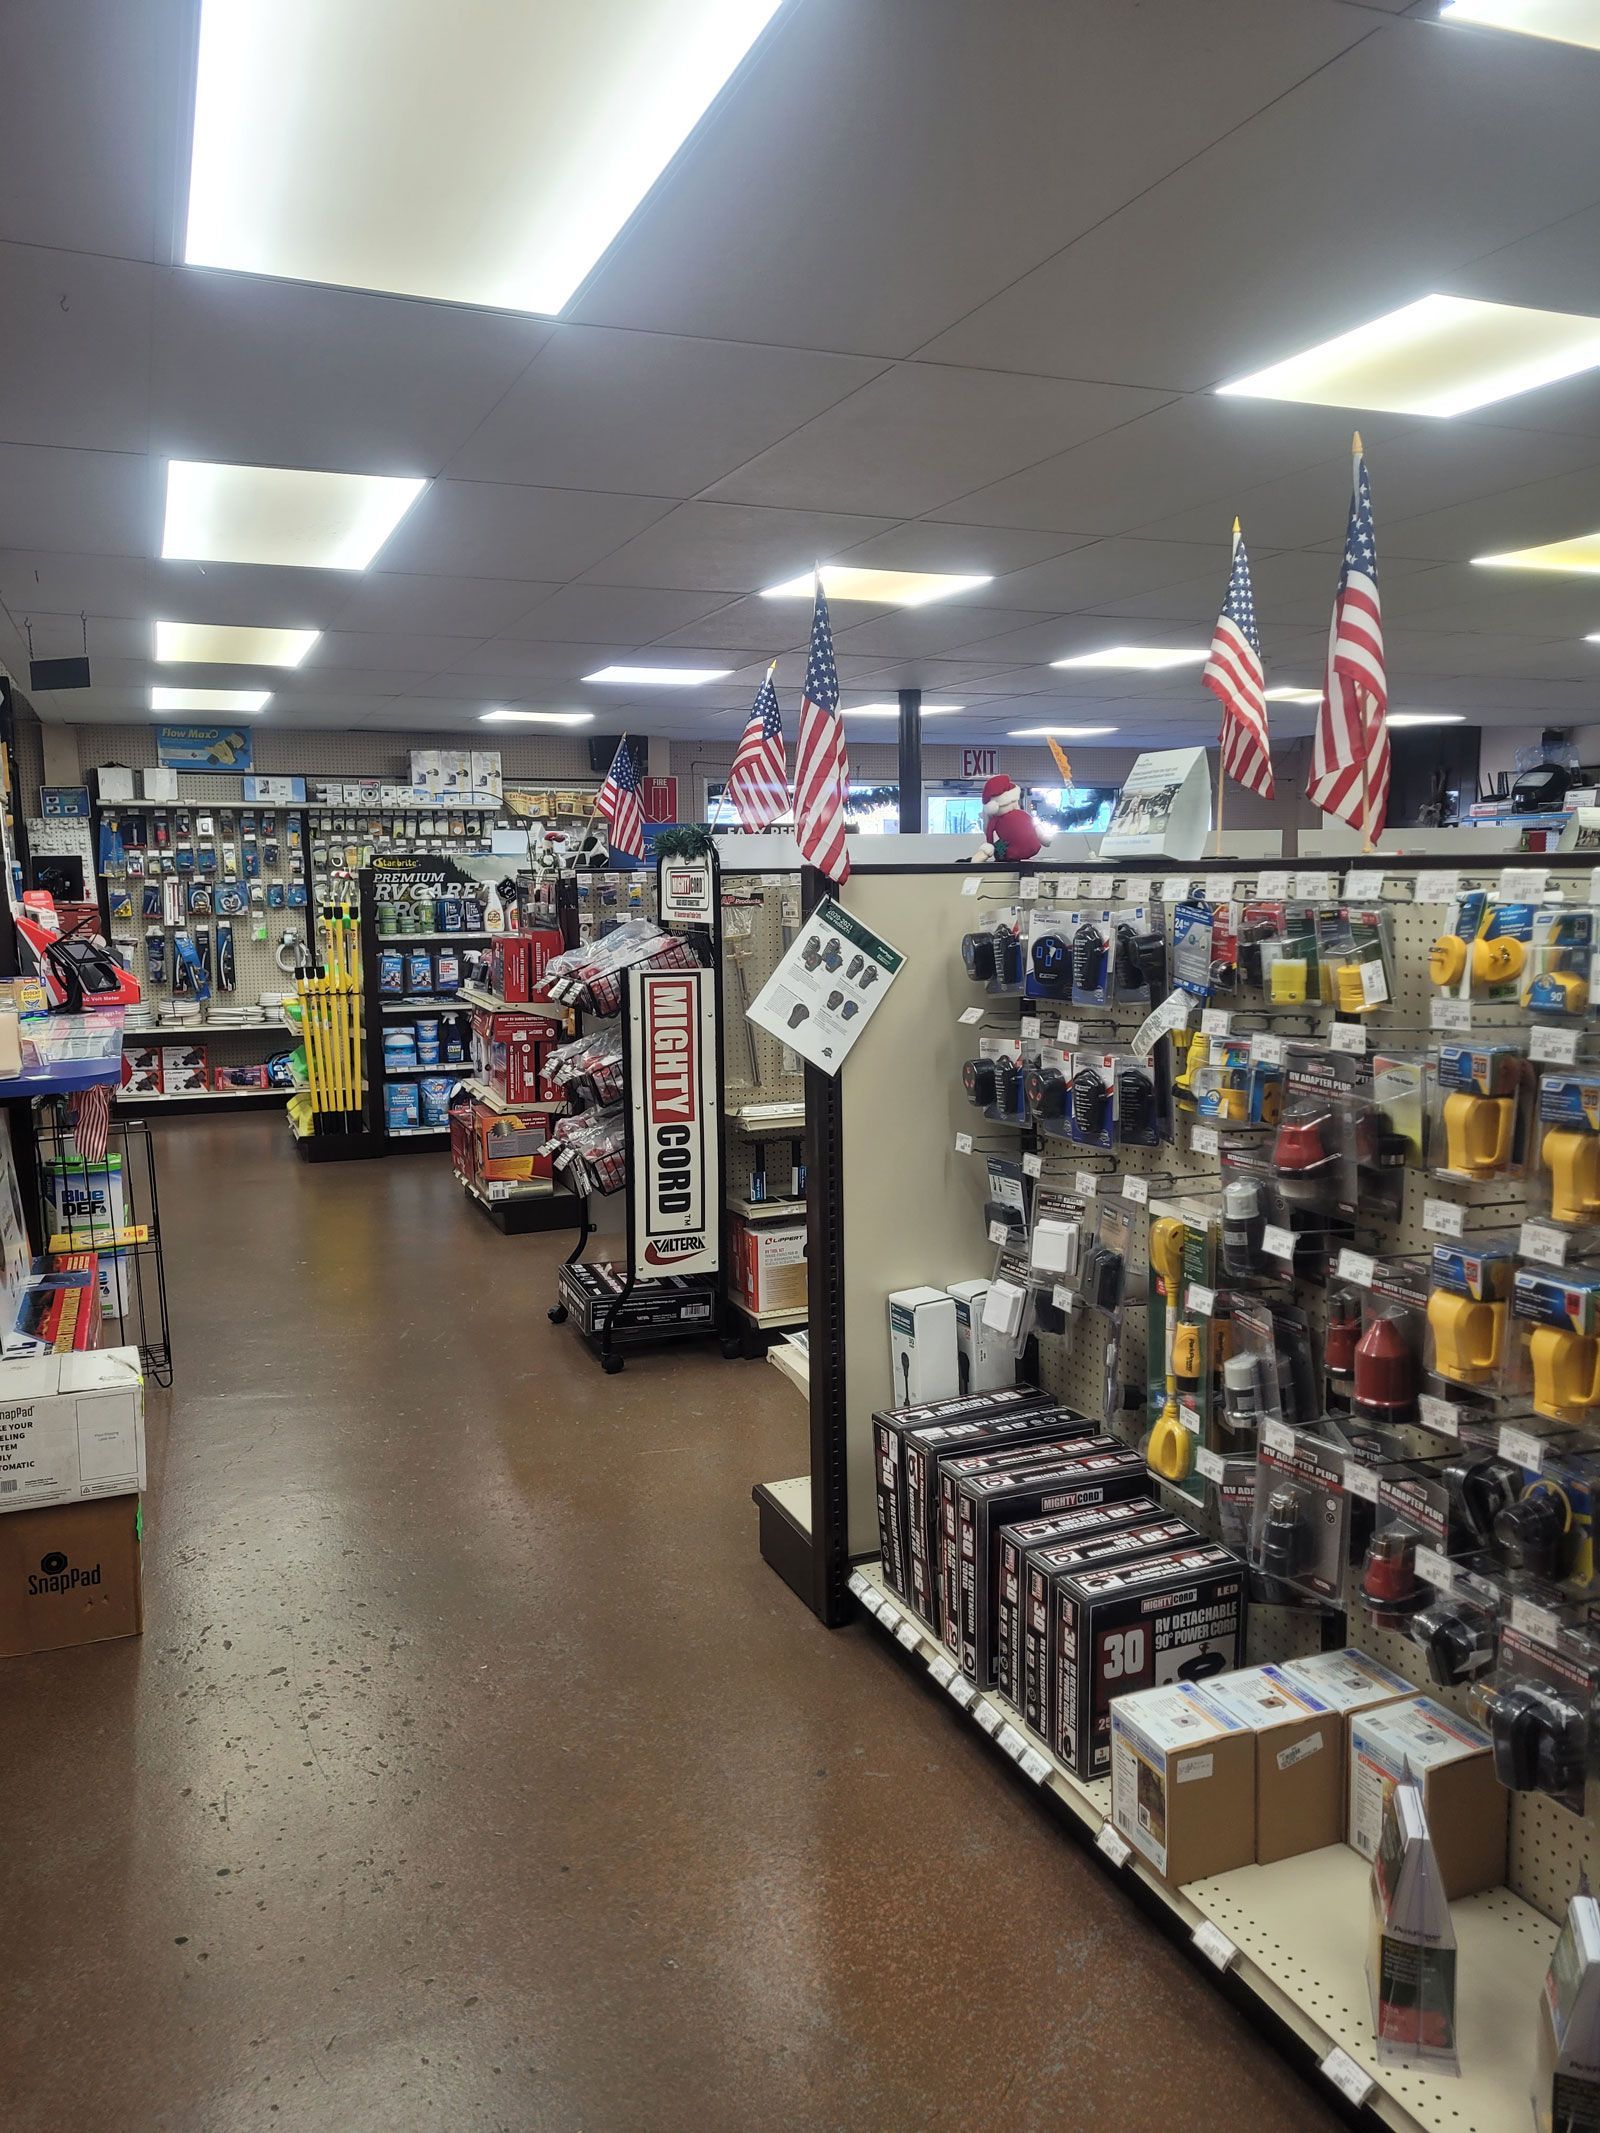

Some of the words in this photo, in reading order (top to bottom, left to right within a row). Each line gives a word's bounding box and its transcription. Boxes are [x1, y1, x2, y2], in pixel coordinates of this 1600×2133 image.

[162, 728, 186, 738] Flow
[963, 749, 997, 776] EXIT
[653, 778, 667, 786] FIRE
[373, 872, 446, 883] PREMIUM
[691, 877, 703, 893] CORD
[374, 883, 409, 900] RV
[410, 882, 481, 900] CARE
[827, 908, 853, 931] 2020-2021
[652, 985, 690, 1114] MIGHTY
[1289, 1071, 1300, 1080] RV
[1300, 1074, 1333, 1088] ADAPTER
[656, 1124, 691, 1215] CORD
[62, 1189, 104, 1203] Blue
[62, 1202, 101, 1217] DEF
[653, 1236, 704, 1254] VALTERRA
[0, 1406, 34, 1422] napPad
[8, 1422, 34, 1430] YOUR
[945, 1424, 980, 1436] 50
[882, 1456, 894, 1490] 50
[1263, 1446, 1276, 1457] RV
[1276, 1451, 1316, 1474] ADAPTER
[1316, 1467, 1339, 1483] PLUG
[1043, 1493, 1077, 1511] MIGHTY
[1077, 1490, 1101, 1503] CORD
[1380, 1480, 1390, 1490] RV
[1391, 1485, 1424, 1512] ADAPTER
[1424, 1504, 1444, 1523] PLUG
[946, 1502, 954, 1536] 50
[1107, 1506, 1136, 1520] 30
[962, 1523, 974, 1558] 30
[1140, 1530, 1171, 1543] 30
[893, 1538, 901, 1569] POWER
[1182, 1554, 1212, 1570] 30
[28, 1563, 101, 1595] SnapPad
[914, 1558, 924, 1594] 50
[1007, 1573, 1017, 1604] 30
[1217, 1583, 1239, 1597] LED
[1142, 1596, 1172, 1612] MIGHTY
[1172, 1591, 1194, 1604] CORD
[1033, 1600, 1046, 1634] 30
[1155, 1616, 1172, 1634] RV
[1172, 1601, 1238, 1629] DETACHABLE
[1064, 1626, 1076, 1660] 30
[1155, 1631, 1174, 1650] 90°
[1174, 1624, 1210, 1646] POWER
[1210, 1616, 1237, 1637] CORD
[1103, 1628, 1145, 1680] 30
